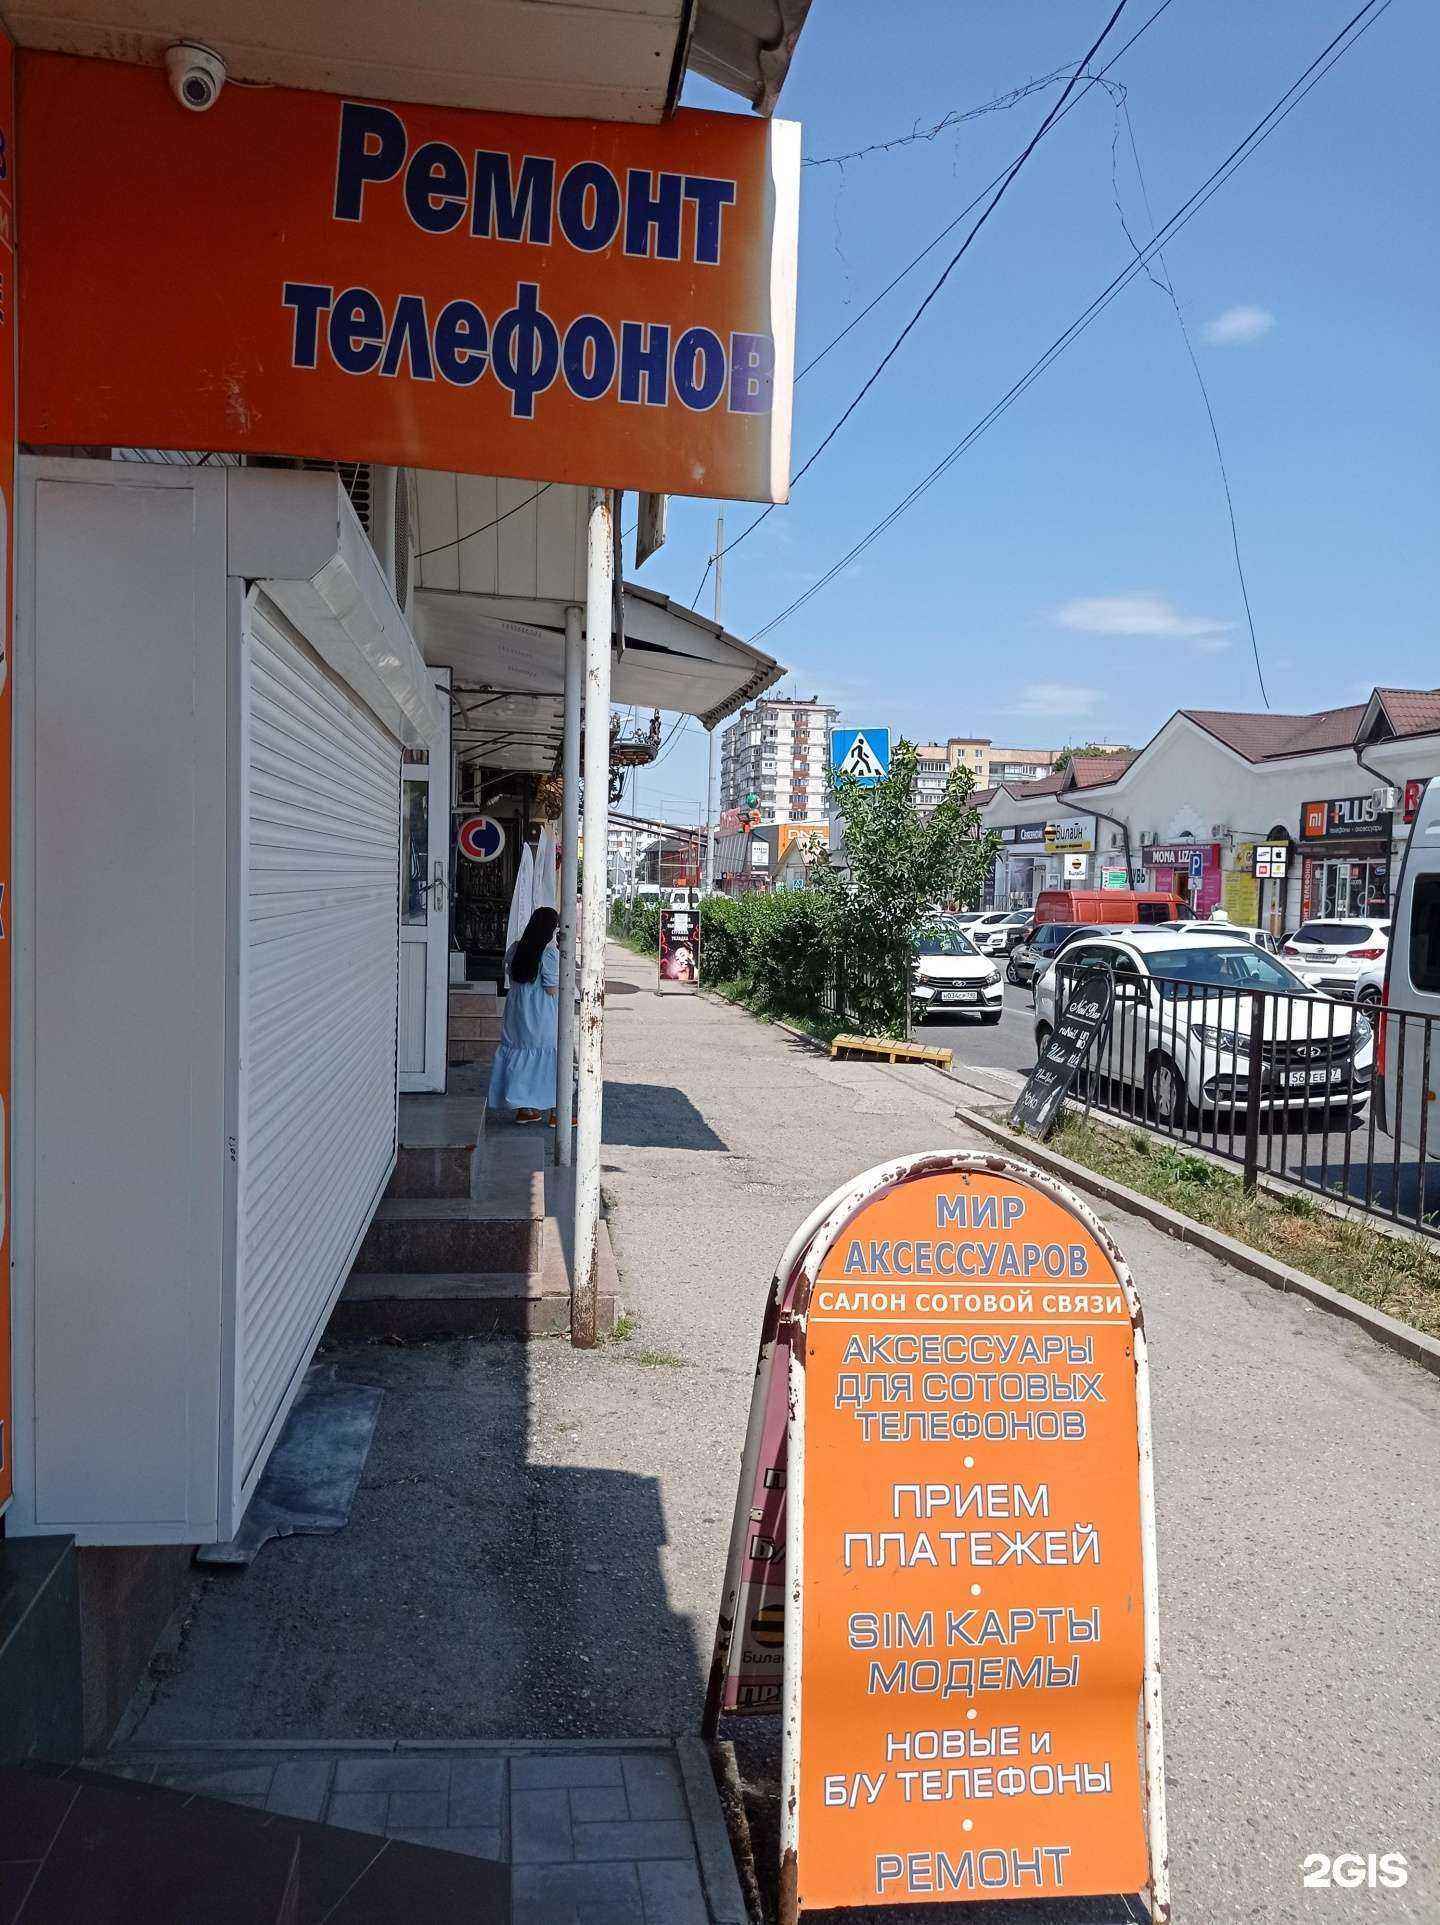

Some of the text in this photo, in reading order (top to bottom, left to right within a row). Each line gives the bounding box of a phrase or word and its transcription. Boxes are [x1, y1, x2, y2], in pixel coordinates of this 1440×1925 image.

[331, 100, 738, 266] Ремонт
[282, 281, 777, 420] телефонов
[935, 1194, 1026, 1230] МИР
[844, 1240, 1090, 1279] АКСЕССУАРОВ
[818, 1288, 1125, 1315] САЛОН СОТОВОЙ СВЯЗИ
[841, 1334, 1094, 1366] АКСЕССУАРЫ
[834, 1371, 1107, 1410] ДЛЯ СОТОВЫХ
[854, 1409, 1088, 1443] ТЕЛЕФОНОВ
[892, 1483, 1050, 1520] ПРИЕМ
[843, 1521, 1101, 1568] ПЛАТЕЖЕЙ
[848, 1607, 1101, 1650] SIM КАРТЫ
[742, 1651, 785, 1665] Била
[867, 1654, 1080, 1699] МОДЕМЫ
[885, 1725, 1021, 1762] НОВЫЕ
[823, 1762, 1113, 1808] Б/У ТЕЛЕФОНЫ
[875, 1846, 1071, 1894] РЕМОНТ
